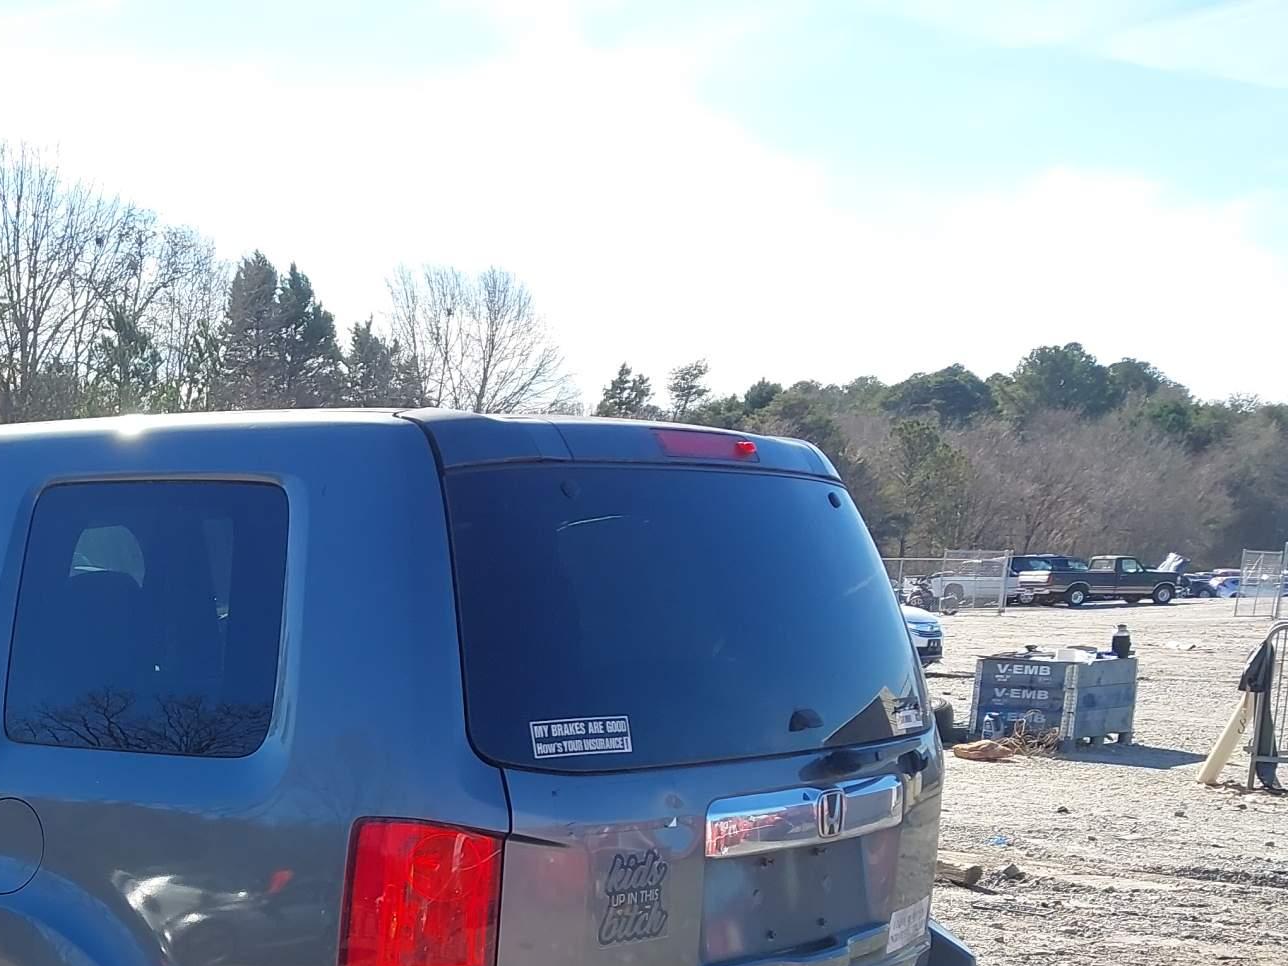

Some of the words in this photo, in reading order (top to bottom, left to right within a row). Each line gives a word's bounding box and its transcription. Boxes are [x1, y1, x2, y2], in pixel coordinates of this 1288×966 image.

[996, 663, 1051, 676] V-EMB
[993, 687, 1049, 700] V-EMB
[534, 725, 549, 738] MY
[551, 722, 585, 737] BRAKES
[588, 721, 605, 734] ARE
[606, 720, 627, 733] GOOD
[563, 739, 584, 752] YOUR
[612, 893, 626, 907] UP
[627, 891, 638, 904] IN
[640, 888, 659, 903] THIS
